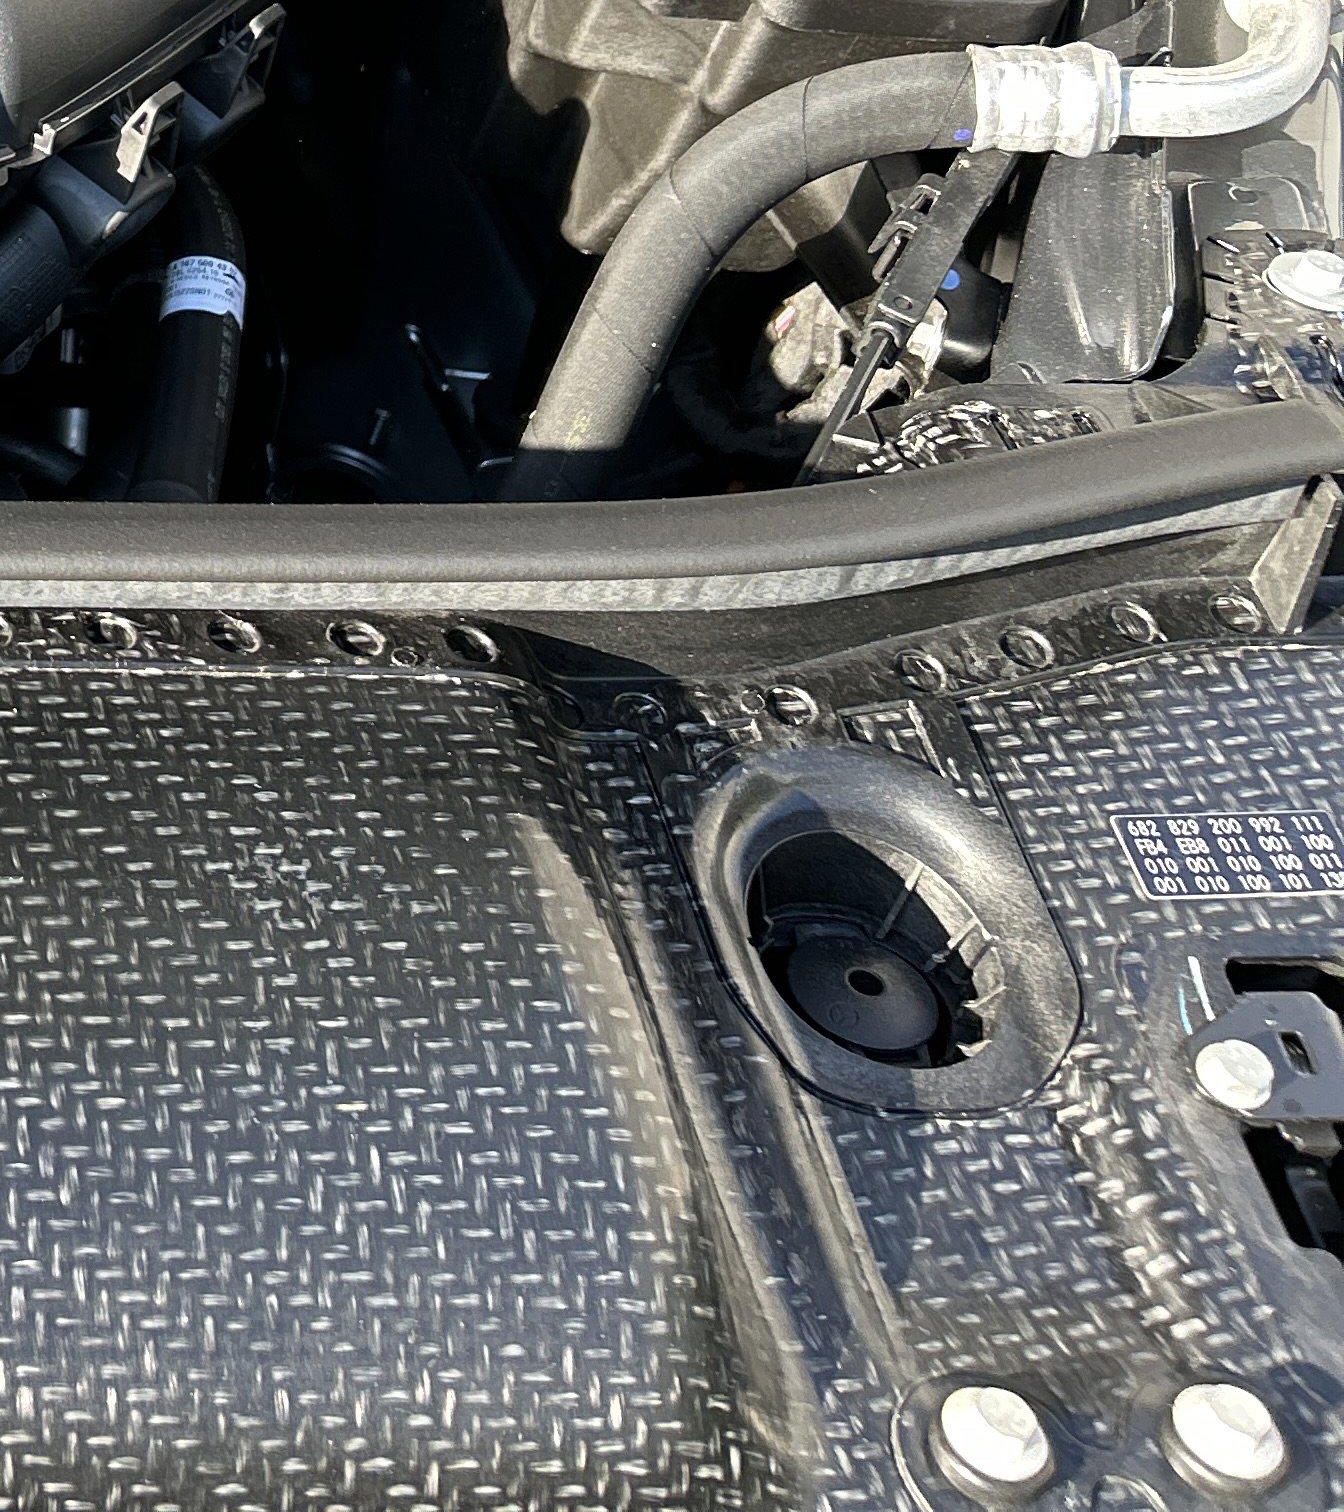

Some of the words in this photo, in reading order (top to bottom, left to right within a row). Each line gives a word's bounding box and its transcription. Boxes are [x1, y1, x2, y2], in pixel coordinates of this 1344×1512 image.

[1127, 820, 1161, 837] 682
[1166, 819, 1200, 836] 829
[1207, 818, 1242, 835] 200
[1290, 815, 1324, 832] 111
[1217, 836, 1251, 853] 011
[1258, 835, 1293, 852] 001
[1300, 833, 1334, 851] 100
[1143, 857, 1179, 875] 010
[1185, 856, 1221, 874] 001
[1226, 855, 1262, 872] 010
[1269, 853, 1303, 871] 100
[1308, 852, 1343, 870] 011
[1153, 876, 1189, 894] 001
[1194, 875, 1230, 893] 010
[1237, 874, 1271, 891] 100
[1278, 873, 1313, 890] 101
